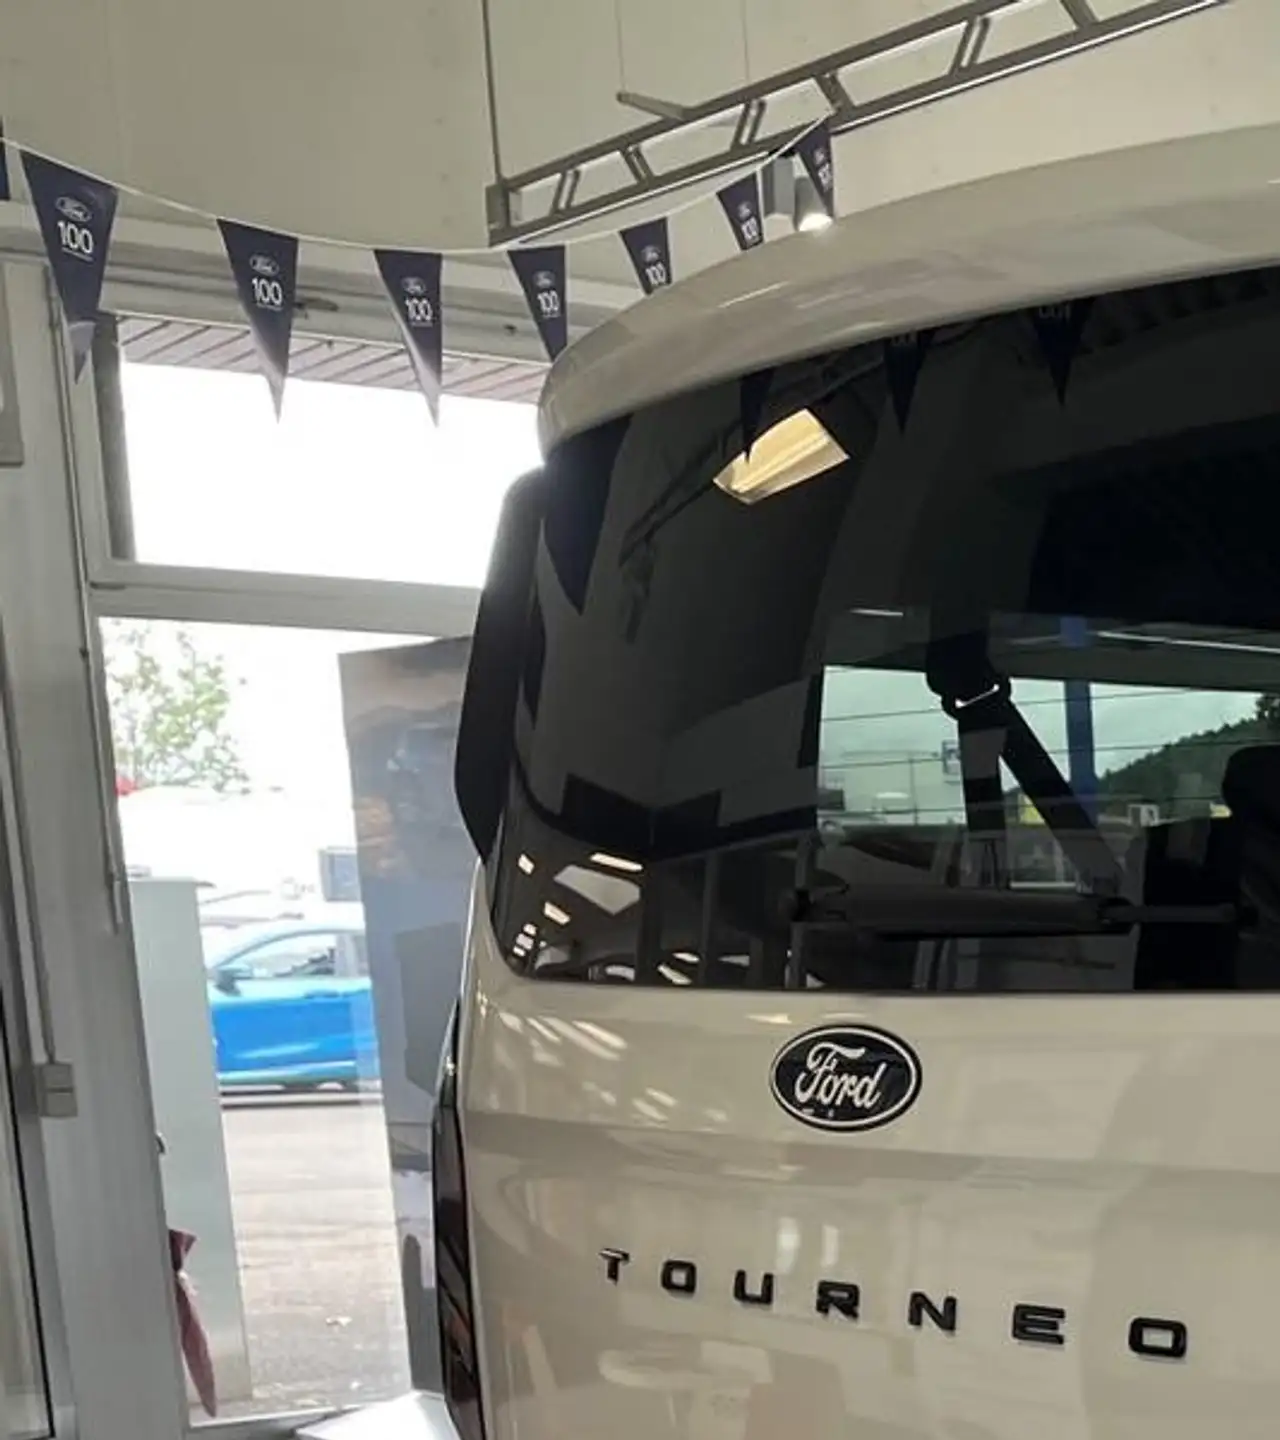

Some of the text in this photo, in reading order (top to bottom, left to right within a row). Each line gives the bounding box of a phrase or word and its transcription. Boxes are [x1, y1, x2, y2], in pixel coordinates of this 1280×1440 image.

[57, 220, 94, 254] 100
[645, 262, 667, 286] 100
[251, 277, 283, 306] 100
[536, 290, 560, 312] 100
[404, 297, 434, 321] 100
[794, 1041, 887, 1110] Ford
[599, 1248, 1188, 1360] TOURNEO
